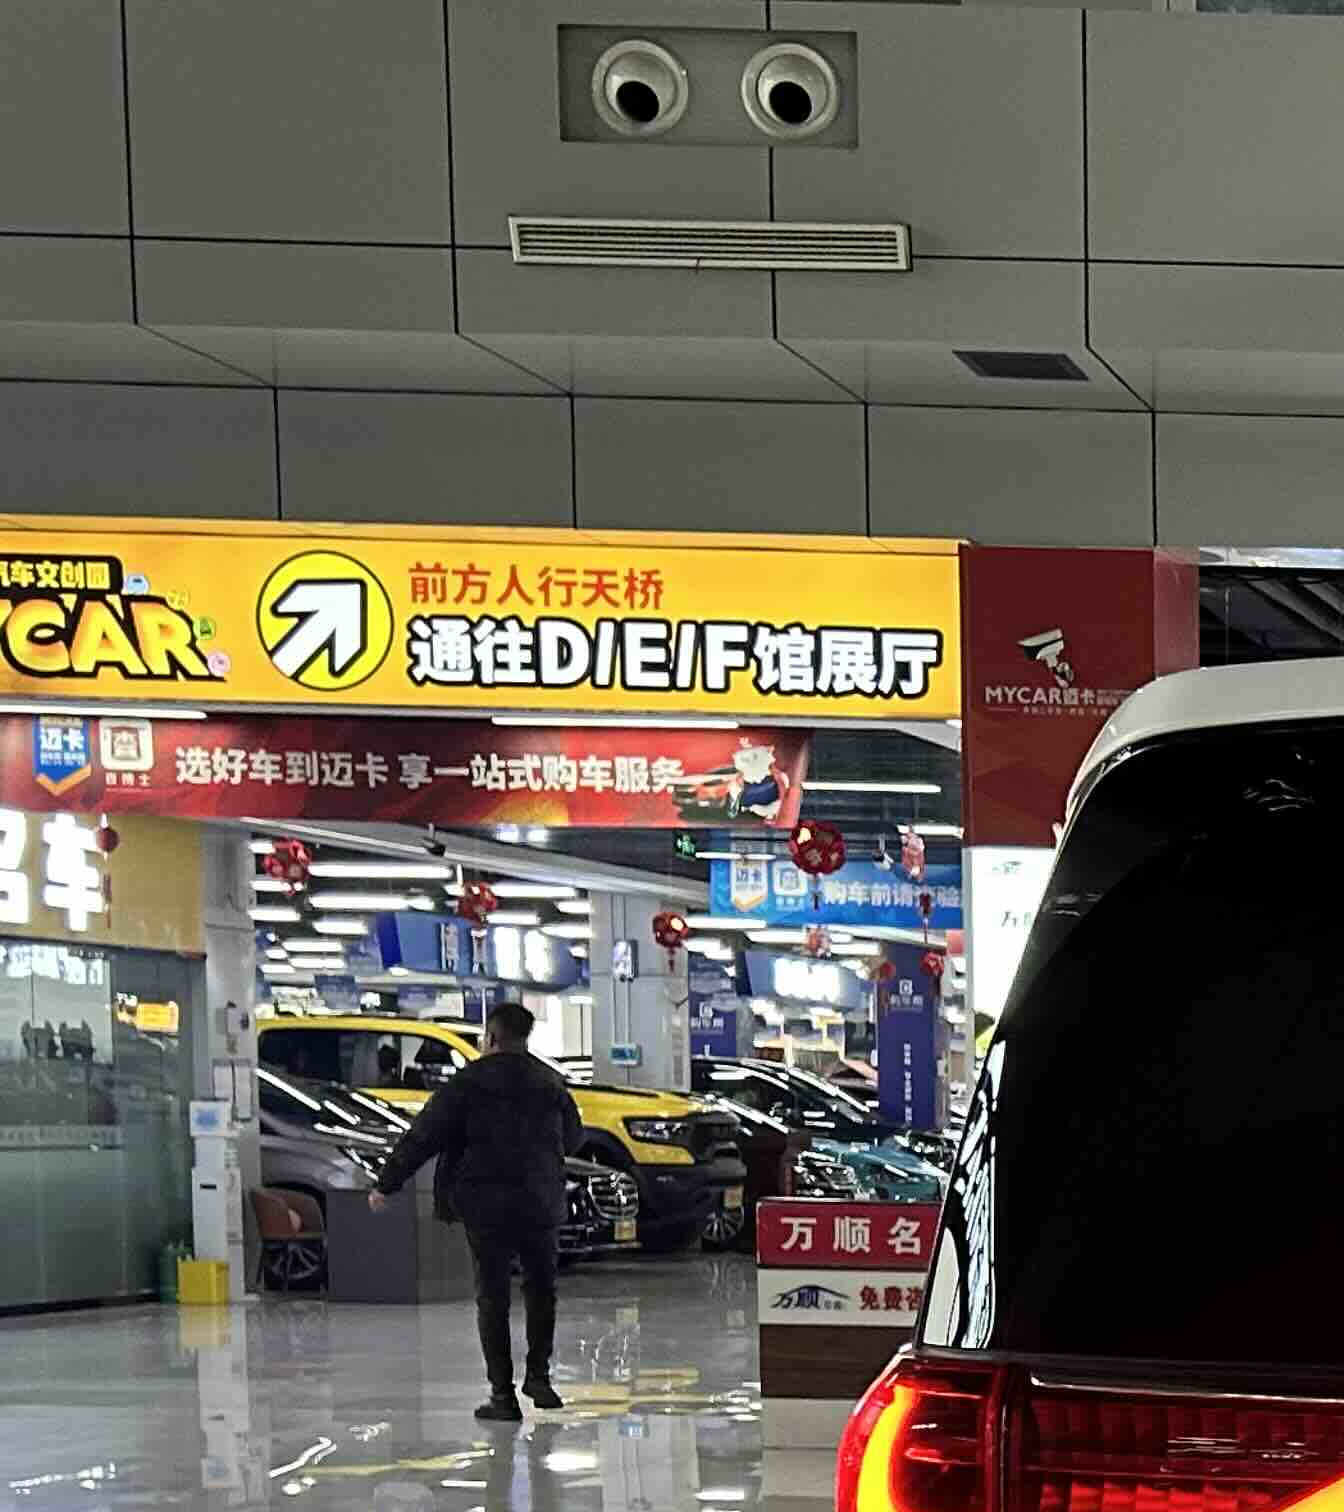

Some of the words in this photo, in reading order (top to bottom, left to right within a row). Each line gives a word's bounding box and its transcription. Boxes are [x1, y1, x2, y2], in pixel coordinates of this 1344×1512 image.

[408, 561, 664, 609] 前方人行天桥
[0, 598, 211, 677] CAR
[409, 616, 940, 698] 通往D/E/F馆展厅
[175, 747, 390, 788] 选好车到迈卡
[397, 752, 686, 794] 享一站式购车服务
[780, 1216, 921, 1254] 万顺名
